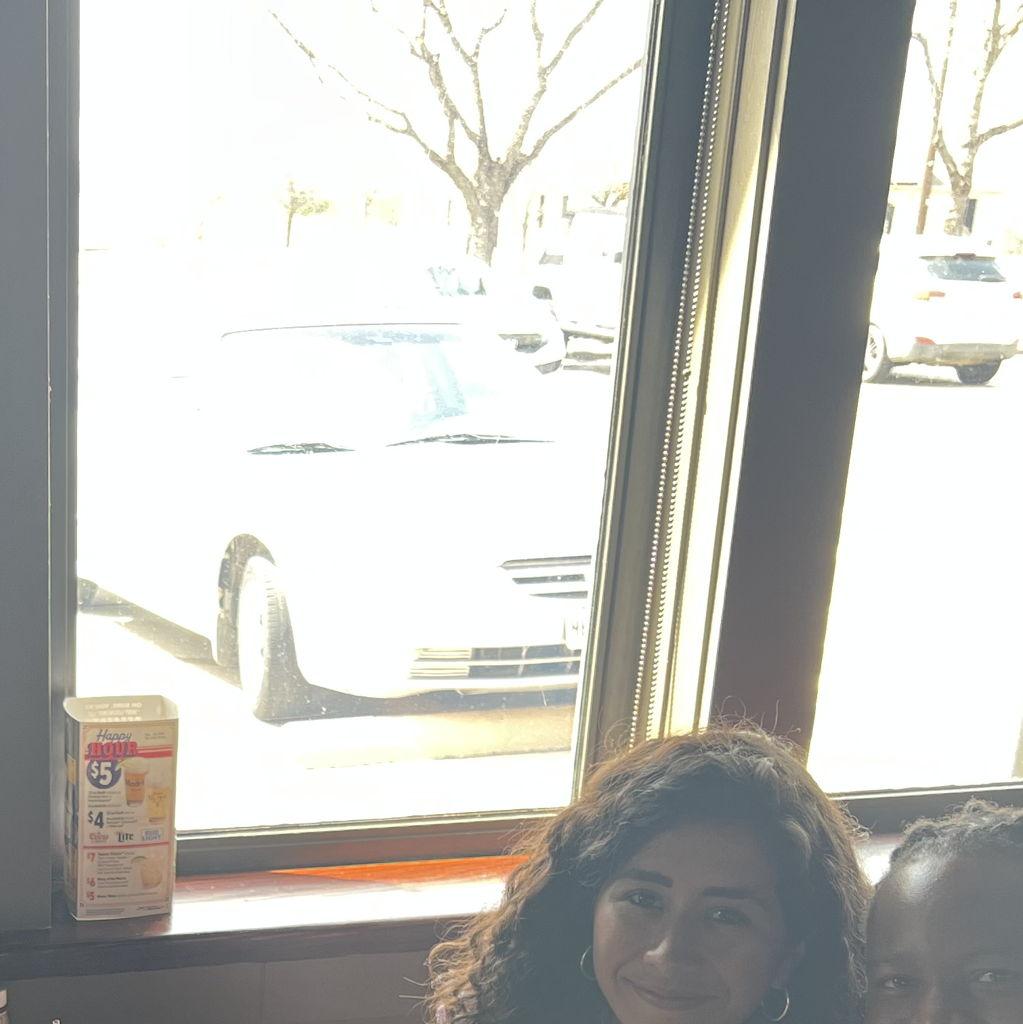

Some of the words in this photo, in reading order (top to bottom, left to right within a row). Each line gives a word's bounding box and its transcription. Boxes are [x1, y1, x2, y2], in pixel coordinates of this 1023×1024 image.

[96, 728, 133, 743] Happy
[88, 740, 138, 759] HOUR
[91, 760, 114, 786] $5
[88, 810, 105, 829] $4
